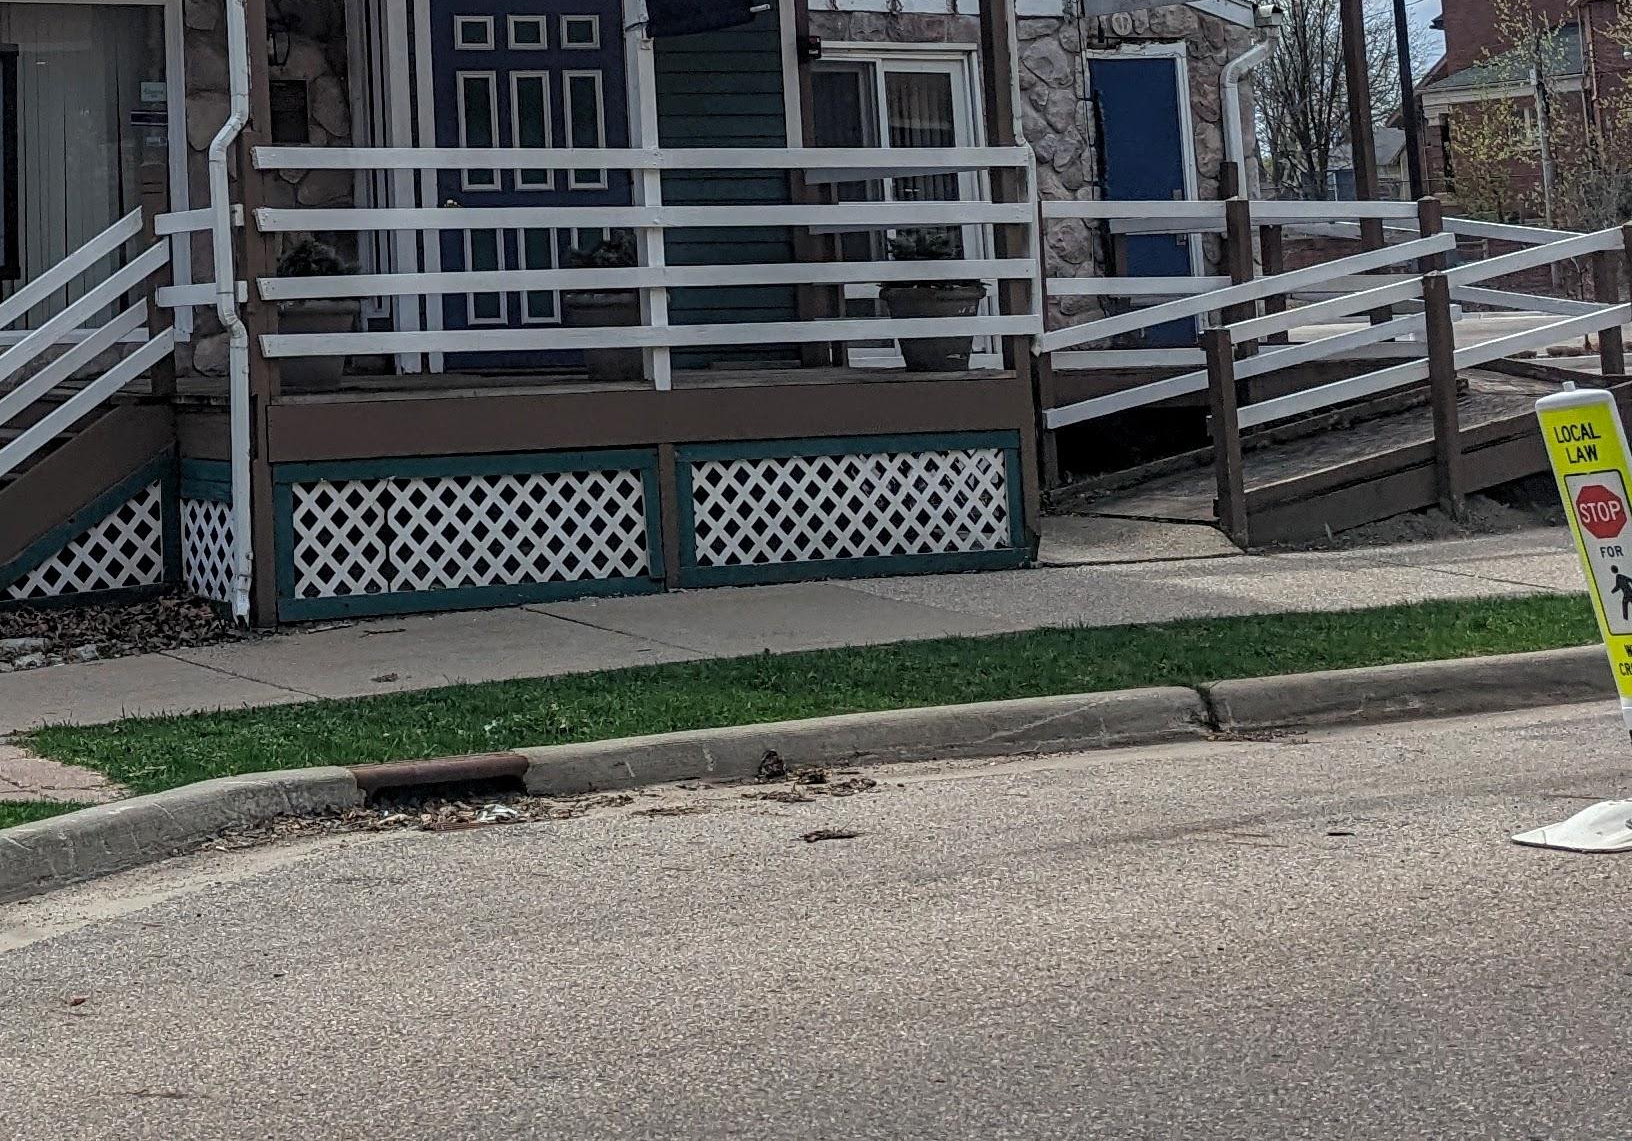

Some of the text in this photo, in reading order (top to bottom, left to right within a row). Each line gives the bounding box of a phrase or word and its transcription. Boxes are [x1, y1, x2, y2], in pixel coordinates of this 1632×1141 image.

[1553, 422, 1602, 444] LOCAL
[1565, 444, 1599, 465] LAW
[1579, 500, 1621, 523] STOP
[1599, 545, 1624, 558] FOR
